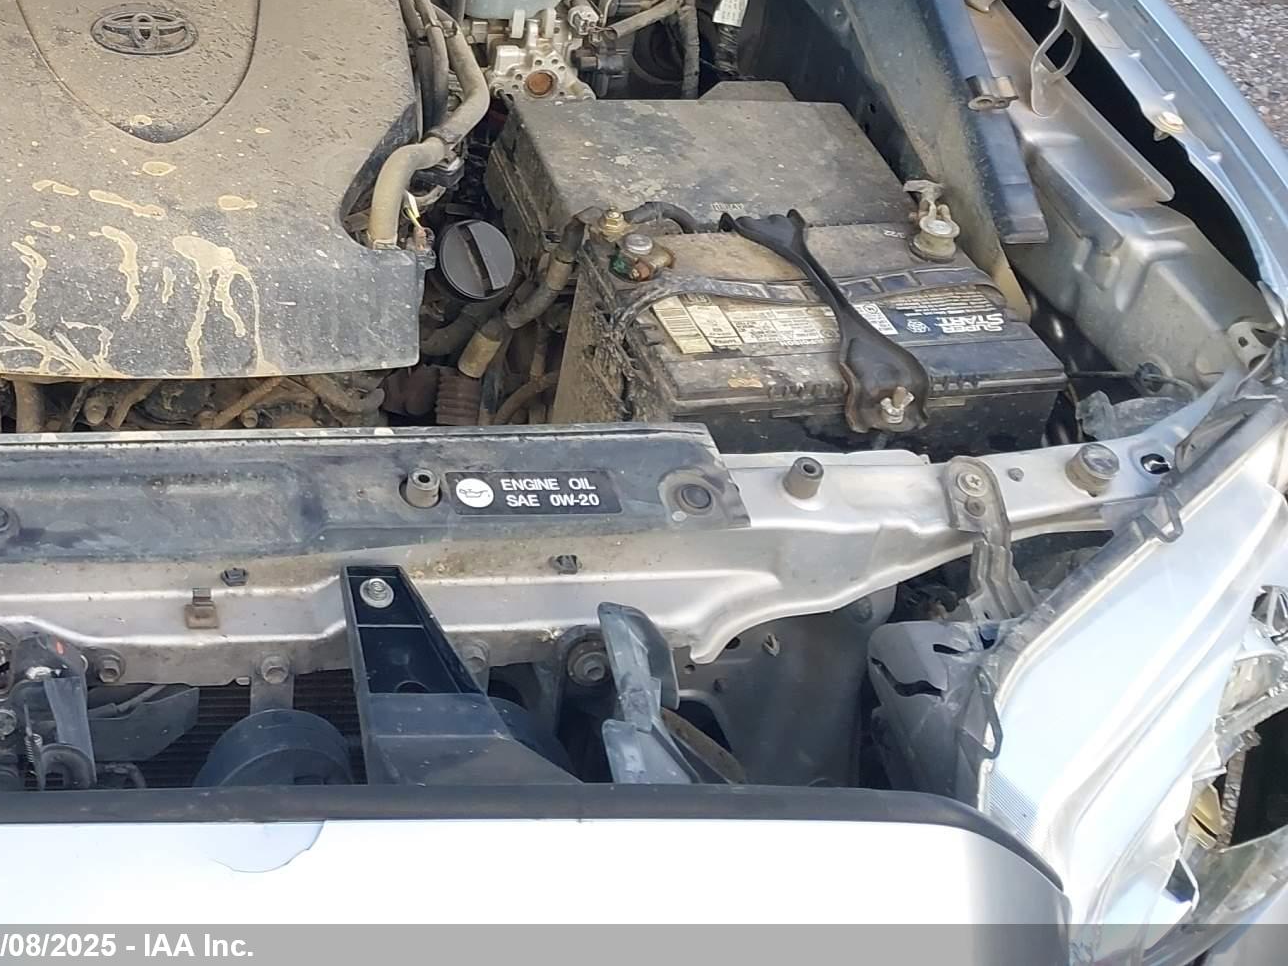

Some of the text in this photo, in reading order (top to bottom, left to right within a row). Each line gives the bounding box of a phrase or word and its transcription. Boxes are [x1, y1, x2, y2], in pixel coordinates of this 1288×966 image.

[941, 323, 1003, 334] SUPER
[500, 478, 596, 491] ENGINE OIL
[506, 493, 600, 507] SAE 0W-20
